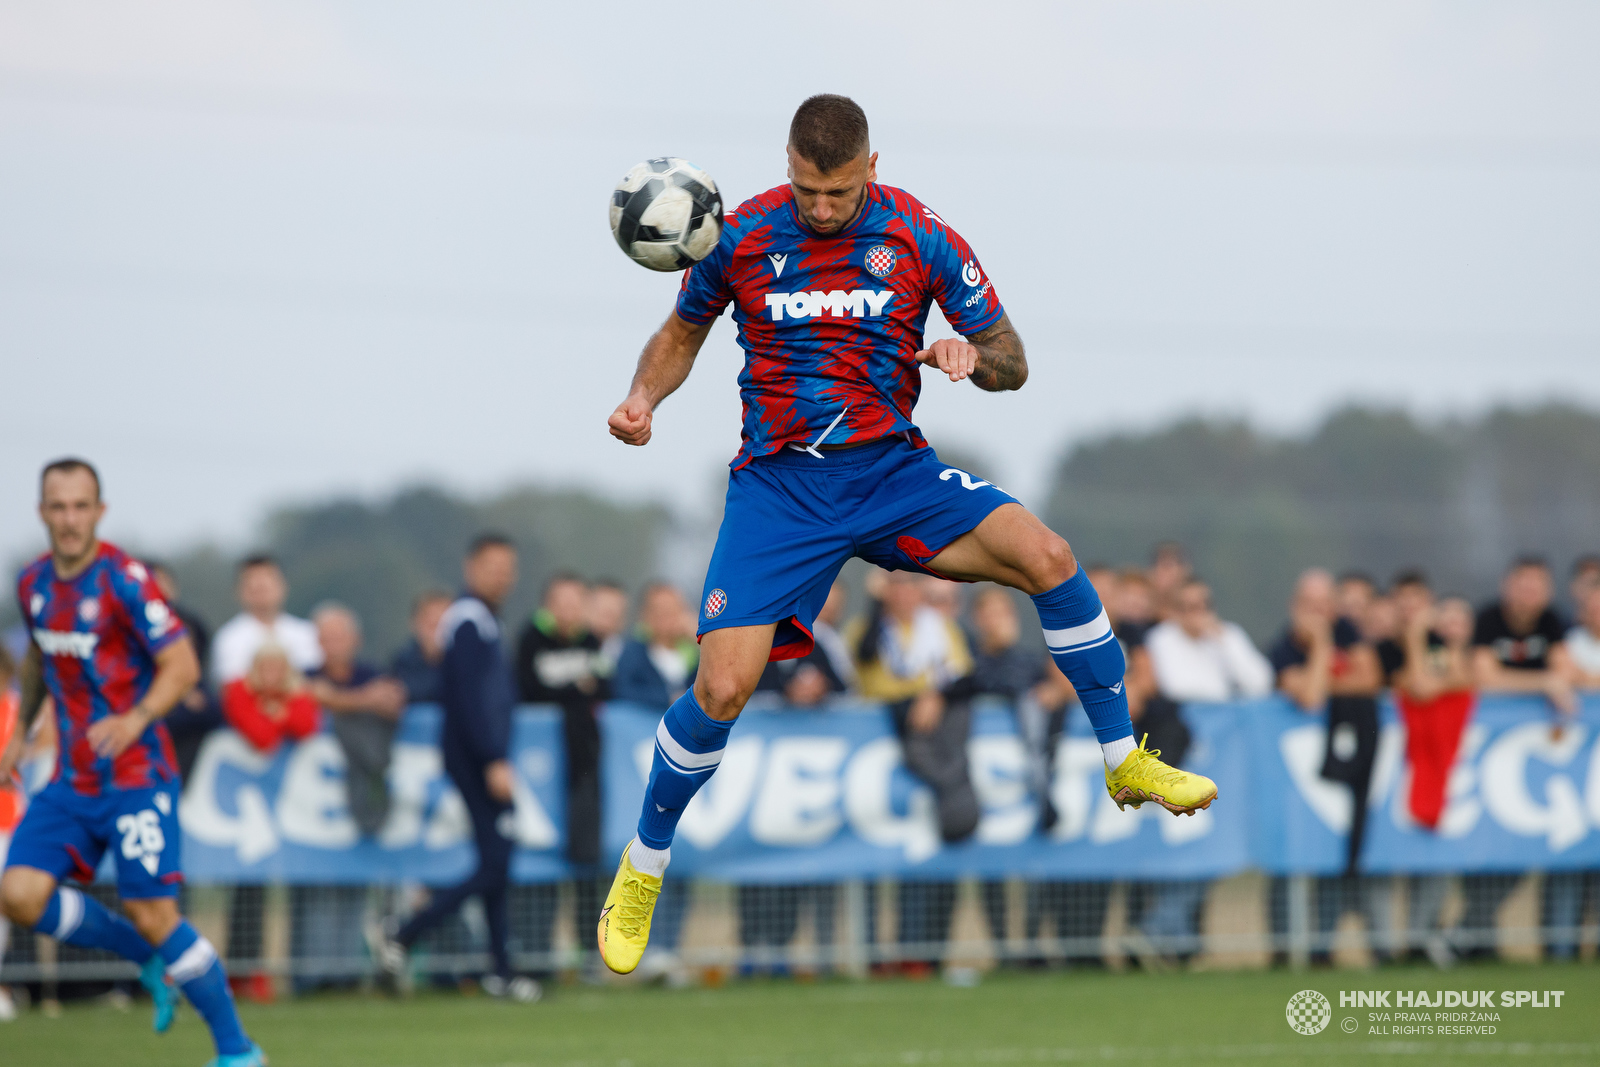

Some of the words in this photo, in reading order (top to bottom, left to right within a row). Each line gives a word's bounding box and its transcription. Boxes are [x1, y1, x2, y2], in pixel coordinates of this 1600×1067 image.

[868, 246, 894, 257] HAJDUK
[870, 267, 890, 276] SPLIT
[765, 290, 894, 320] TOMMY
[116, 808, 166, 861] 26
